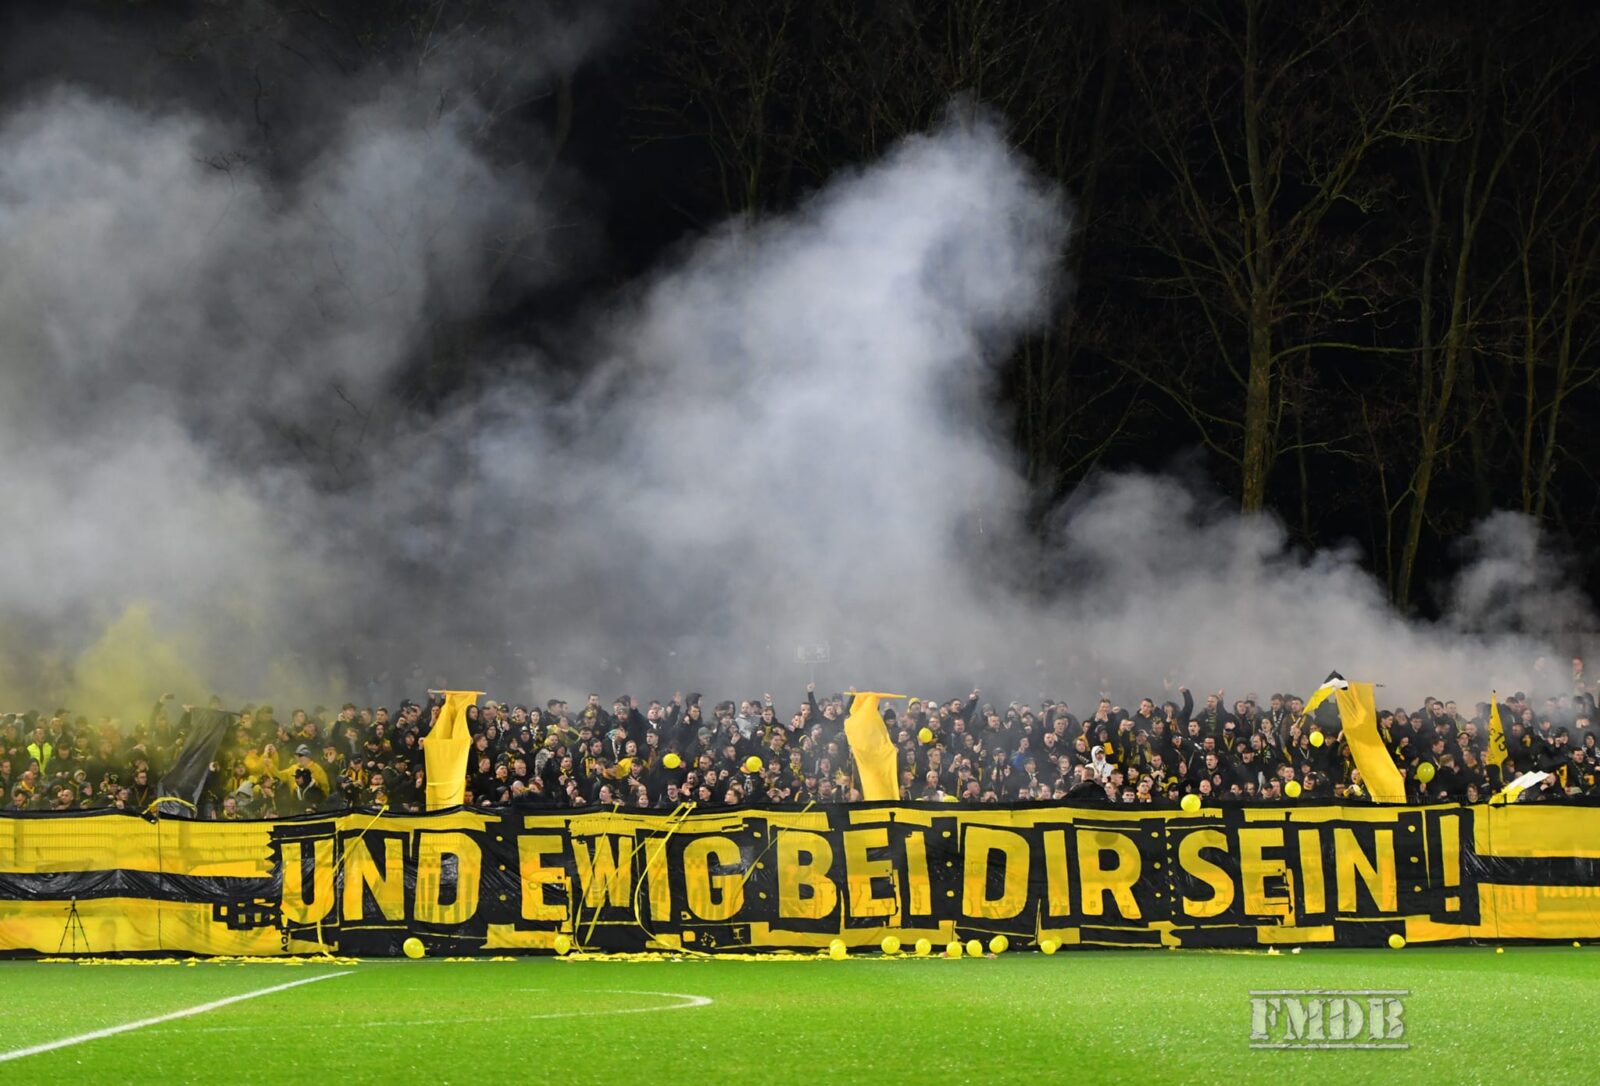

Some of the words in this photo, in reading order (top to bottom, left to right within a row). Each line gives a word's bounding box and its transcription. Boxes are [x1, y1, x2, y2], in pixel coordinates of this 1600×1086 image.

[280, 832, 482, 924] UND
[517, 834, 744, 921] EWIG
[777, 827, 932, 920] BEI
[961, 824, 1143, 919] DIR
[1178, 826, 1399, 918] SEIN
